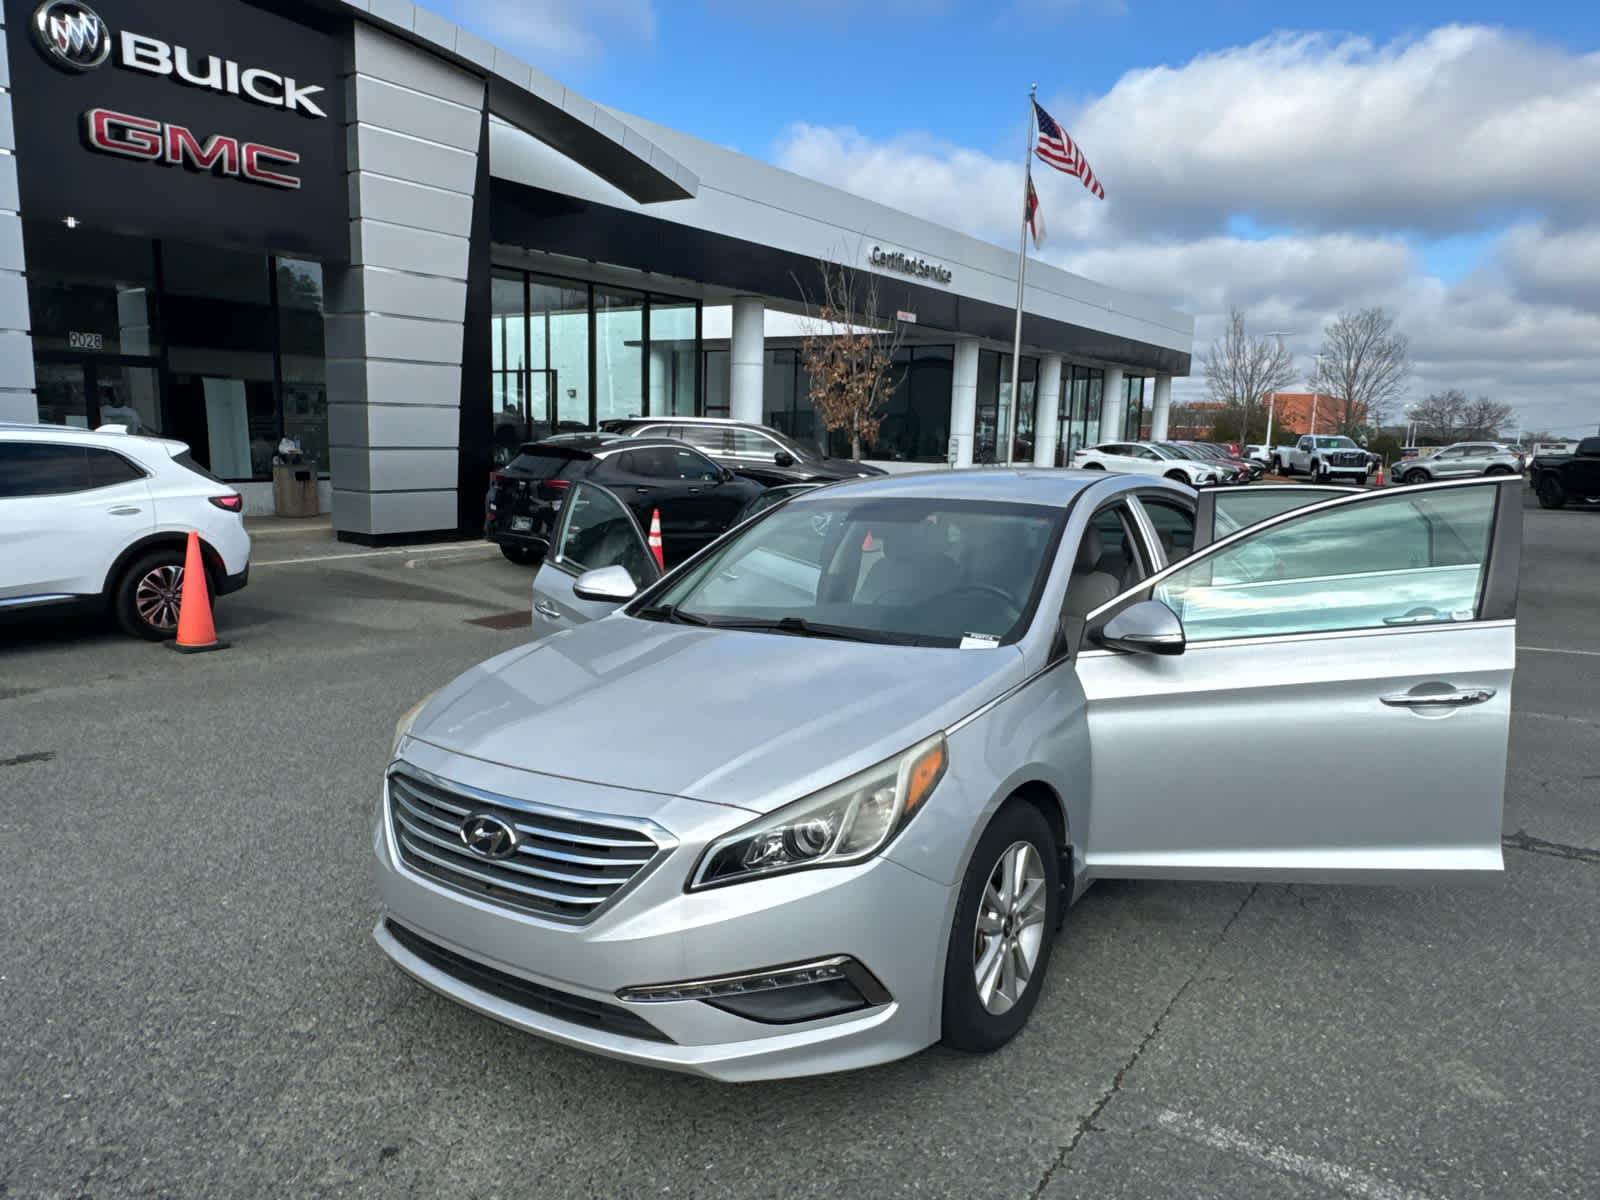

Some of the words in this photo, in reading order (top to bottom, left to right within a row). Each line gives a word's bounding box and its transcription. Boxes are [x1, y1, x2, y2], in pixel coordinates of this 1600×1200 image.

[120, 30, 327, 117] BUICK
[87, 108, 300, 189] GMC
[870, 246, 917, 274] Certified
[917, 259, 952, 283] Service
